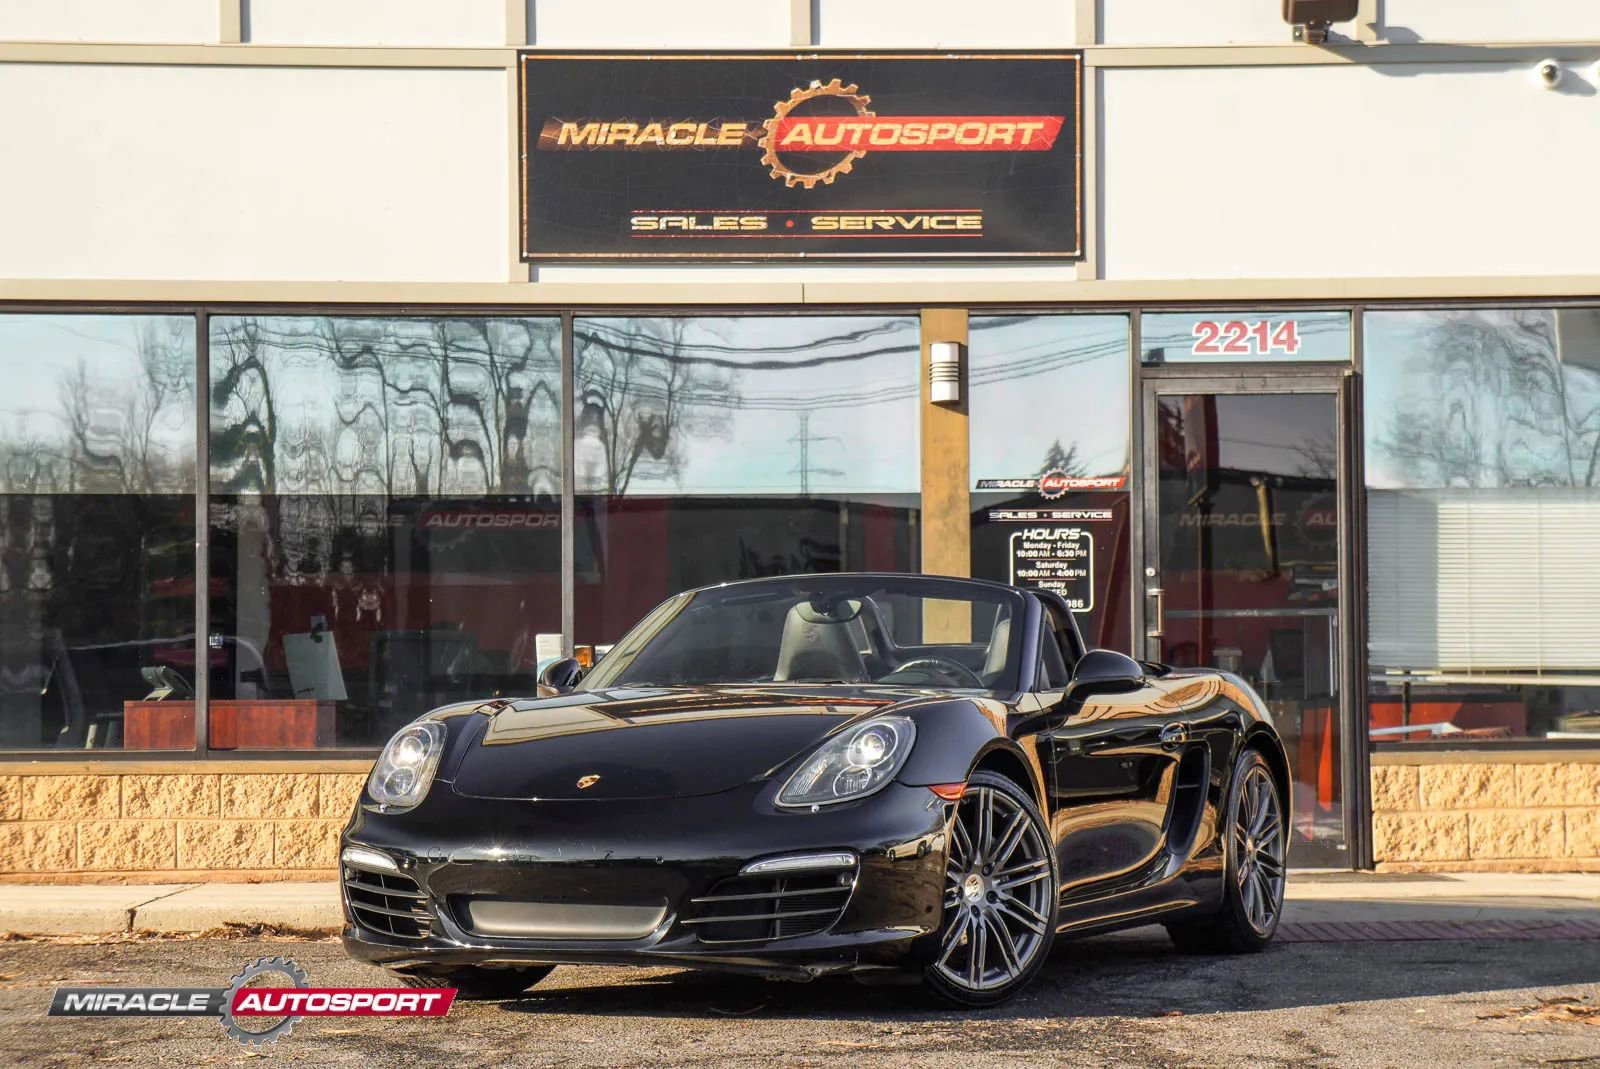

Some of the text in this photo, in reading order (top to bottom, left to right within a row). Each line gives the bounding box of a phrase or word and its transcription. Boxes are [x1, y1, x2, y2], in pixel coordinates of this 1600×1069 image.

[557, 121, 1045, 146] MIRACLE AUTOSPORT
[630, 214, 983, 231] SALES SERVICE
[1193, 319, 1300, 354] 2214
[980, 478, 1121, 488] MIRACLE AUTOSPORT
[425, 513, 561, 528] AUTOSPOR
[988, 511, 1113, 519] SALES SERVICE
[1179, 513, 1287, 526] MIRACE
[1022, 528, 1081, 540] HOURS
[1023, 541, 1052, 550] Monday
[1057, 541, 1080, 550] Friday
[1016, 550, 1038, 558] 10:00
[1035, 561, 1068, 570] Saturday
[1038, 581, 1066, 589] Sunday
